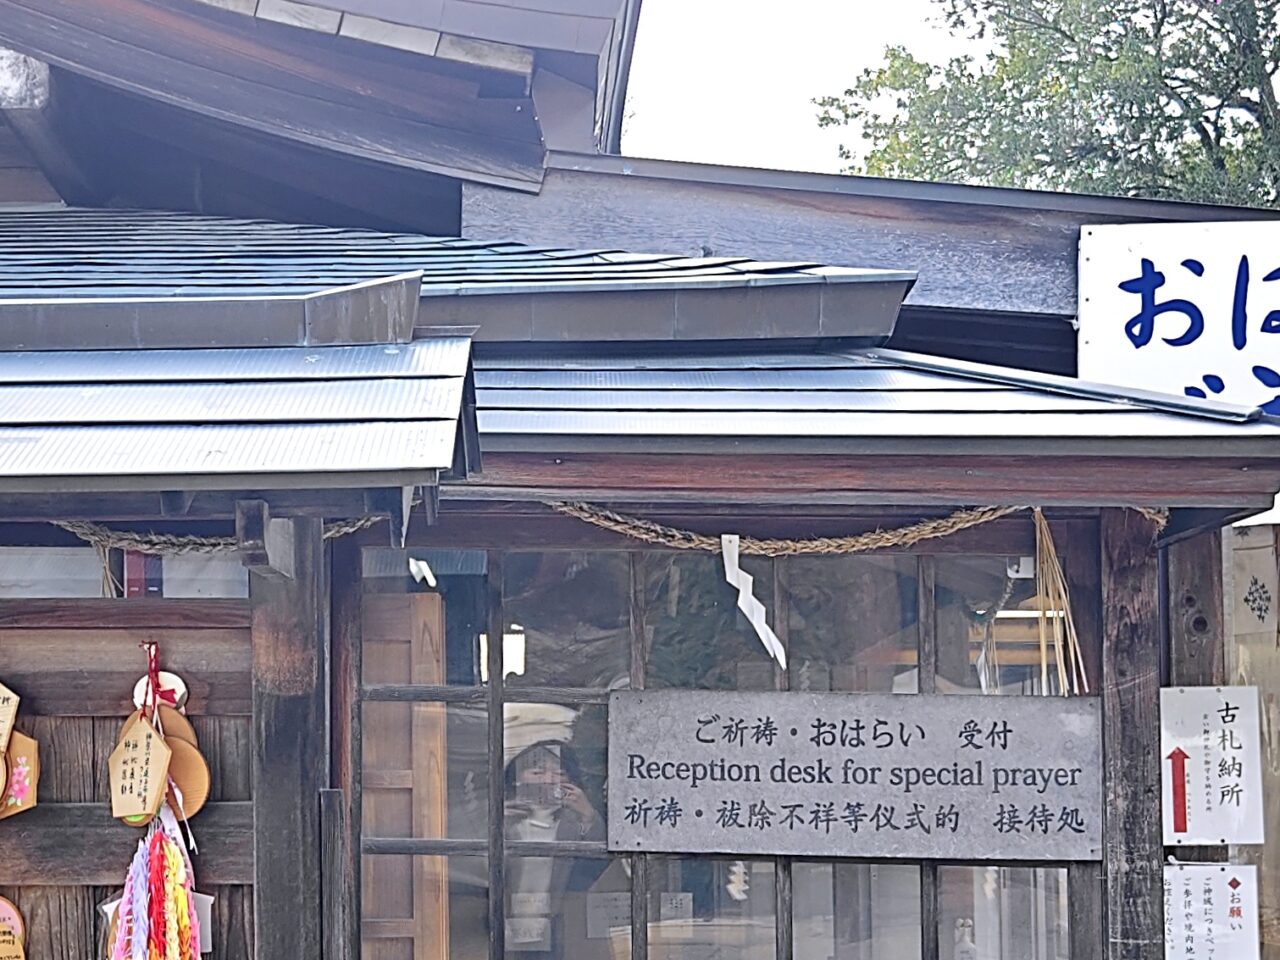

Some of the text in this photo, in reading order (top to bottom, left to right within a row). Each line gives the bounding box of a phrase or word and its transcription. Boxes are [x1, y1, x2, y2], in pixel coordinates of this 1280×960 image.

[695, 714, 1013, 750] ご祈祷・おはらい 受付
[1217, 701, 1244, 807] 古札納所
[626, 754, 1082, 794] Reception desk for special prayer
[624, 797, 1086, 834] 祈祷・祓除不祥等仪式的 接待処
[1228, 892, 1243, 931] お願い
